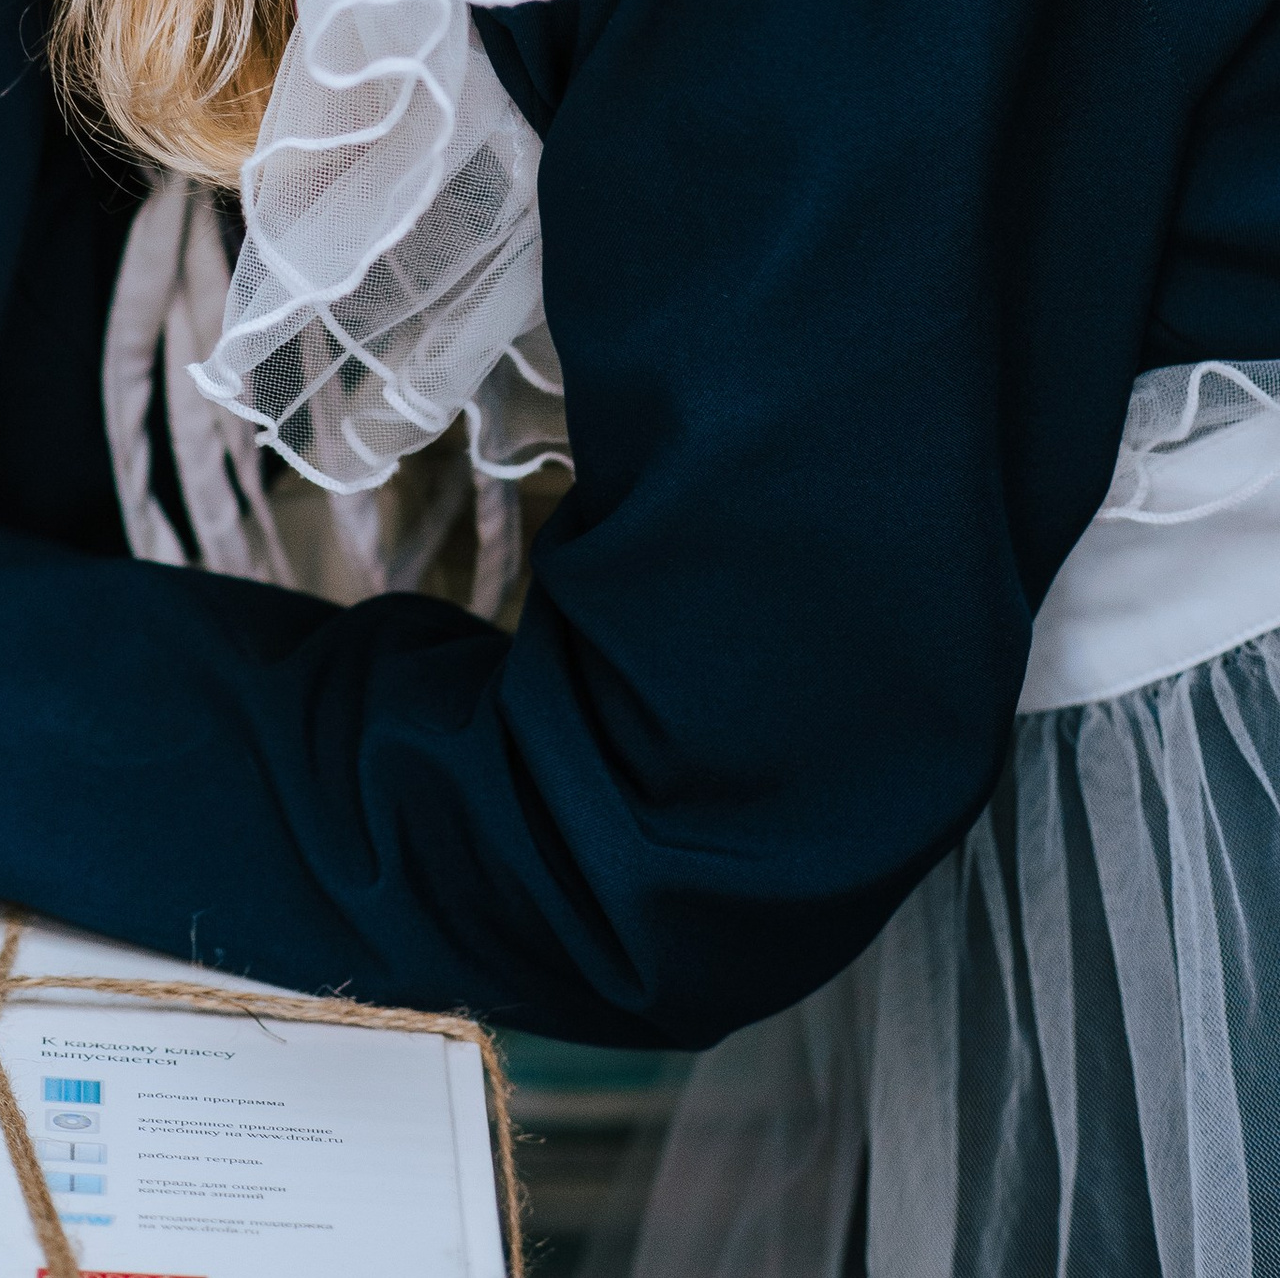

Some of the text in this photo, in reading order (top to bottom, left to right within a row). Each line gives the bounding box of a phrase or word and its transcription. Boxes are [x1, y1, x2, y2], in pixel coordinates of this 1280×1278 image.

[42, 1036, 236, 1061] К каждому классу
[41, 1050, 178, 1066] выпускается
[137, 1092, 286, 1108] рабочая программа
[137, 1117, 333, 1135] электронное приложение
[149, 1127, 220, 1138] учебнику
[246, 1132, 344, 1145] www.drofa.ru
[138, 1152, 264, 1165] рабочая тетрадь
[137, 1178, 287, 1193] тетрадь для оценки
[138, 1187, 265, 1200] качества знаний
